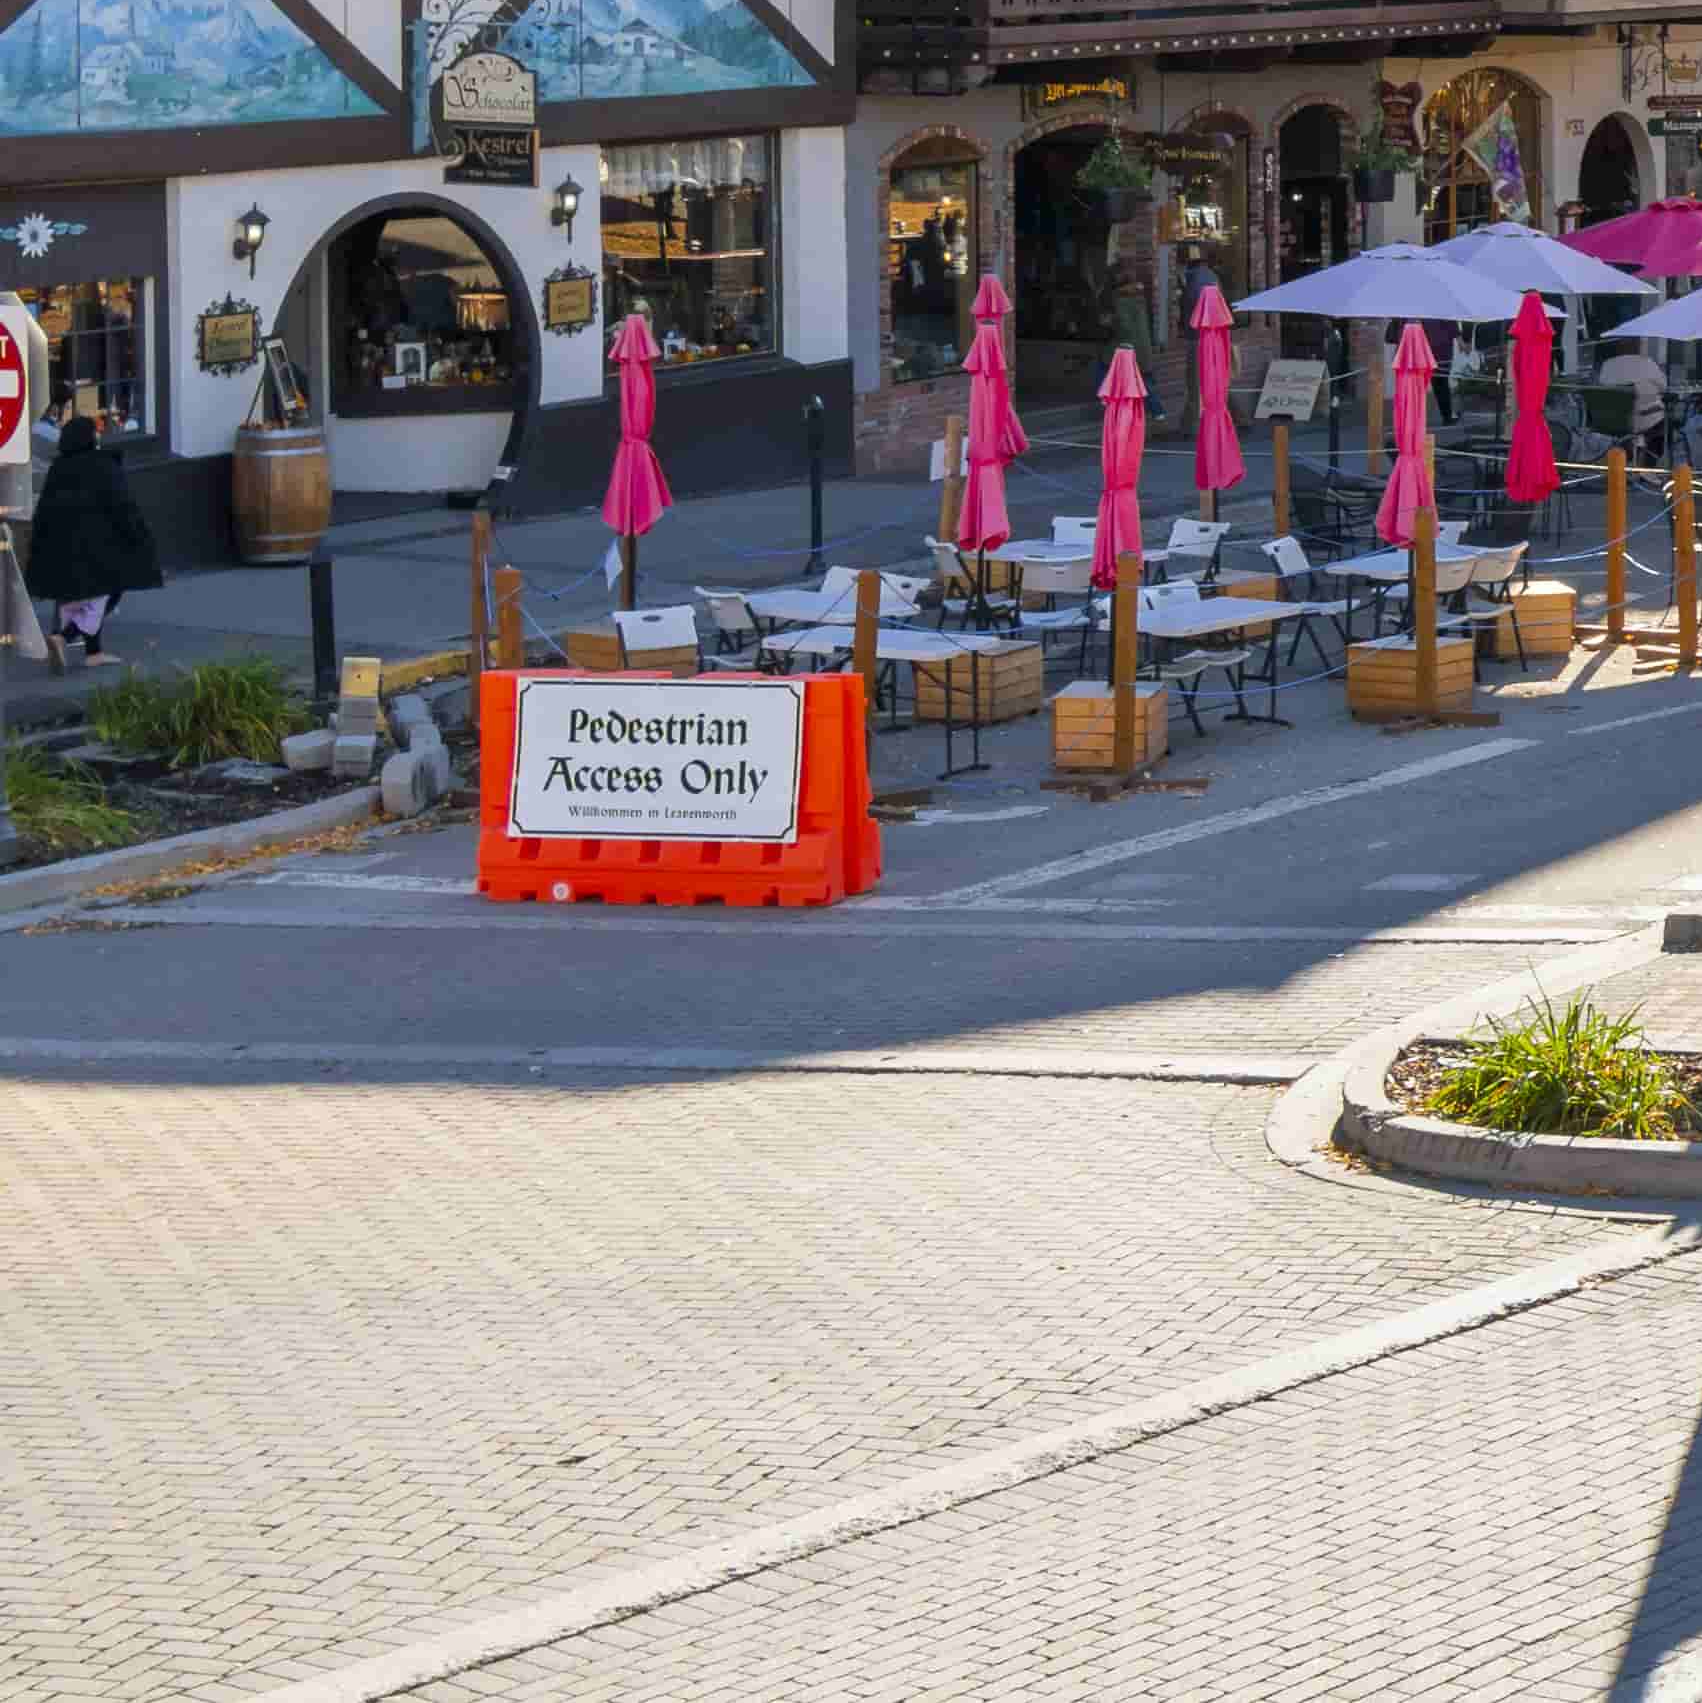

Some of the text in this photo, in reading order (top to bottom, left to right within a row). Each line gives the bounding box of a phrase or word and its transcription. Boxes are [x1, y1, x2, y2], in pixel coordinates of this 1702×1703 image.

[567, 708, 748, 746] Pedestrian
[543, 756, 769, 804] Access Only
[567, 804, 643, 819] Willkommen
[664, 806, 738, 820] Leavenworth
